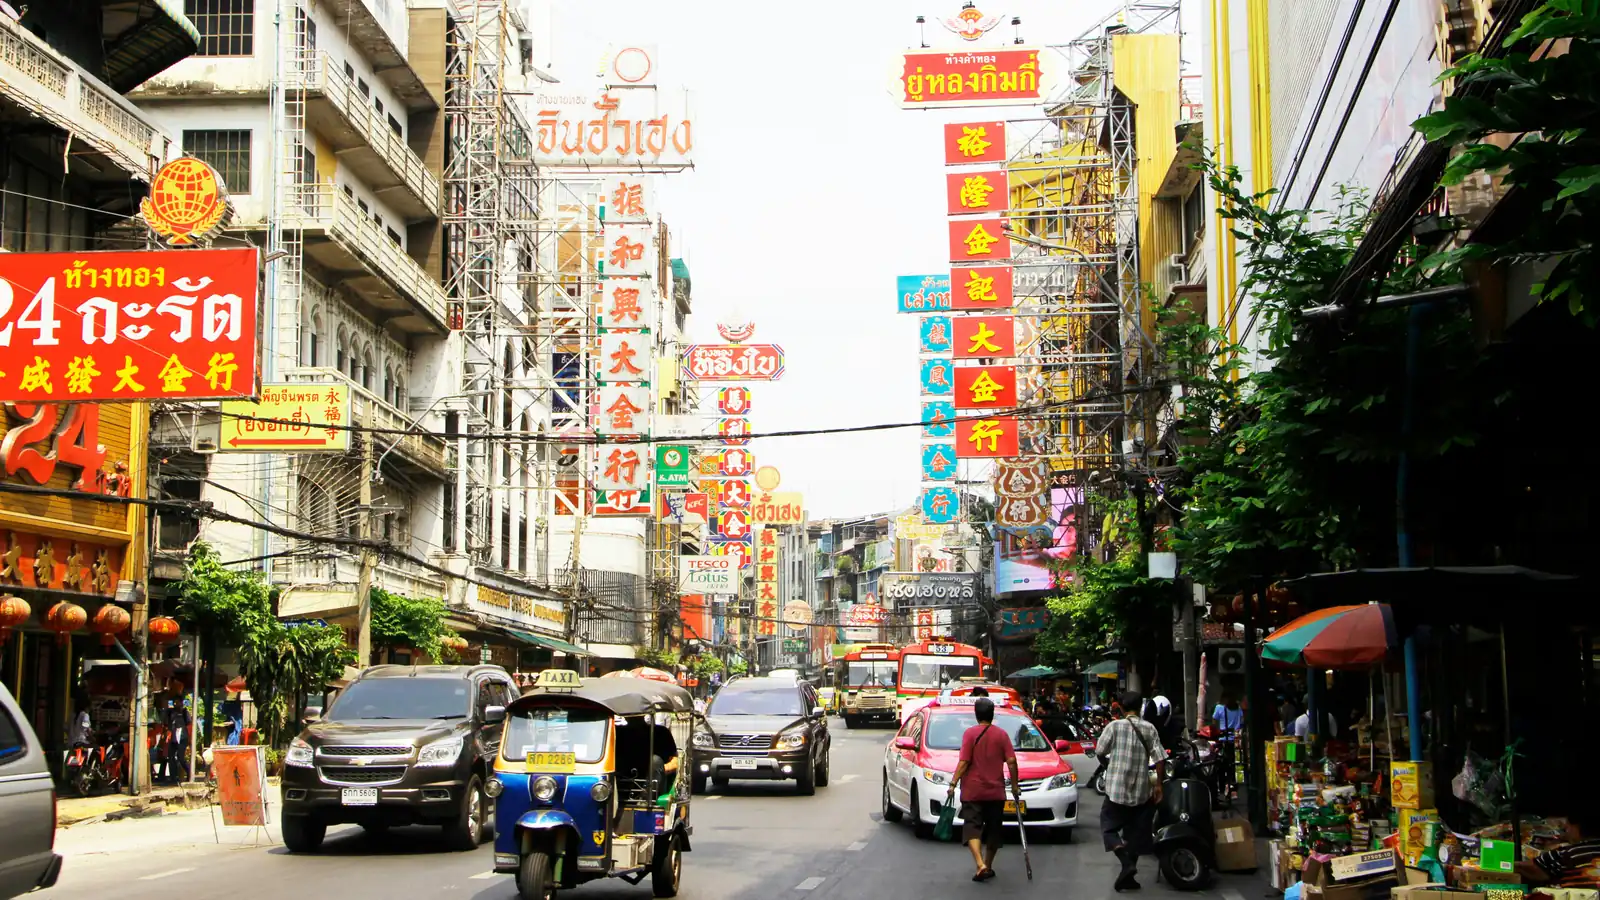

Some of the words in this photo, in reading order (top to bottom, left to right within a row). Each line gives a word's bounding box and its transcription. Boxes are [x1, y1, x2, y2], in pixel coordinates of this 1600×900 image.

[945, 53, 996, 64] ห้างค้าทอง
[907, 53, 1036, 101] ยู่หลงกิมกี่
[63, 260, 165, 289] ห้างทอง
[957, 126, 1004, 452] 裕隆金記大金行
[76, 276, 243, 344] กะรัต
[604, 182, 645, 484] 振和興大金行
[0, 352, 239, 394] 成發大金行
[261, 388, 319, 405] พ็ญจีนพรต
[324, 388, 341, 440] 永福寺
[687, 499, 704, 509] KFC
[688, 560, 729, 569] TESCO
[689, 571, 728, 583] Lotus
[544, 672, 574, 683] TAXI
[547, 754, 573, 765] 2286
